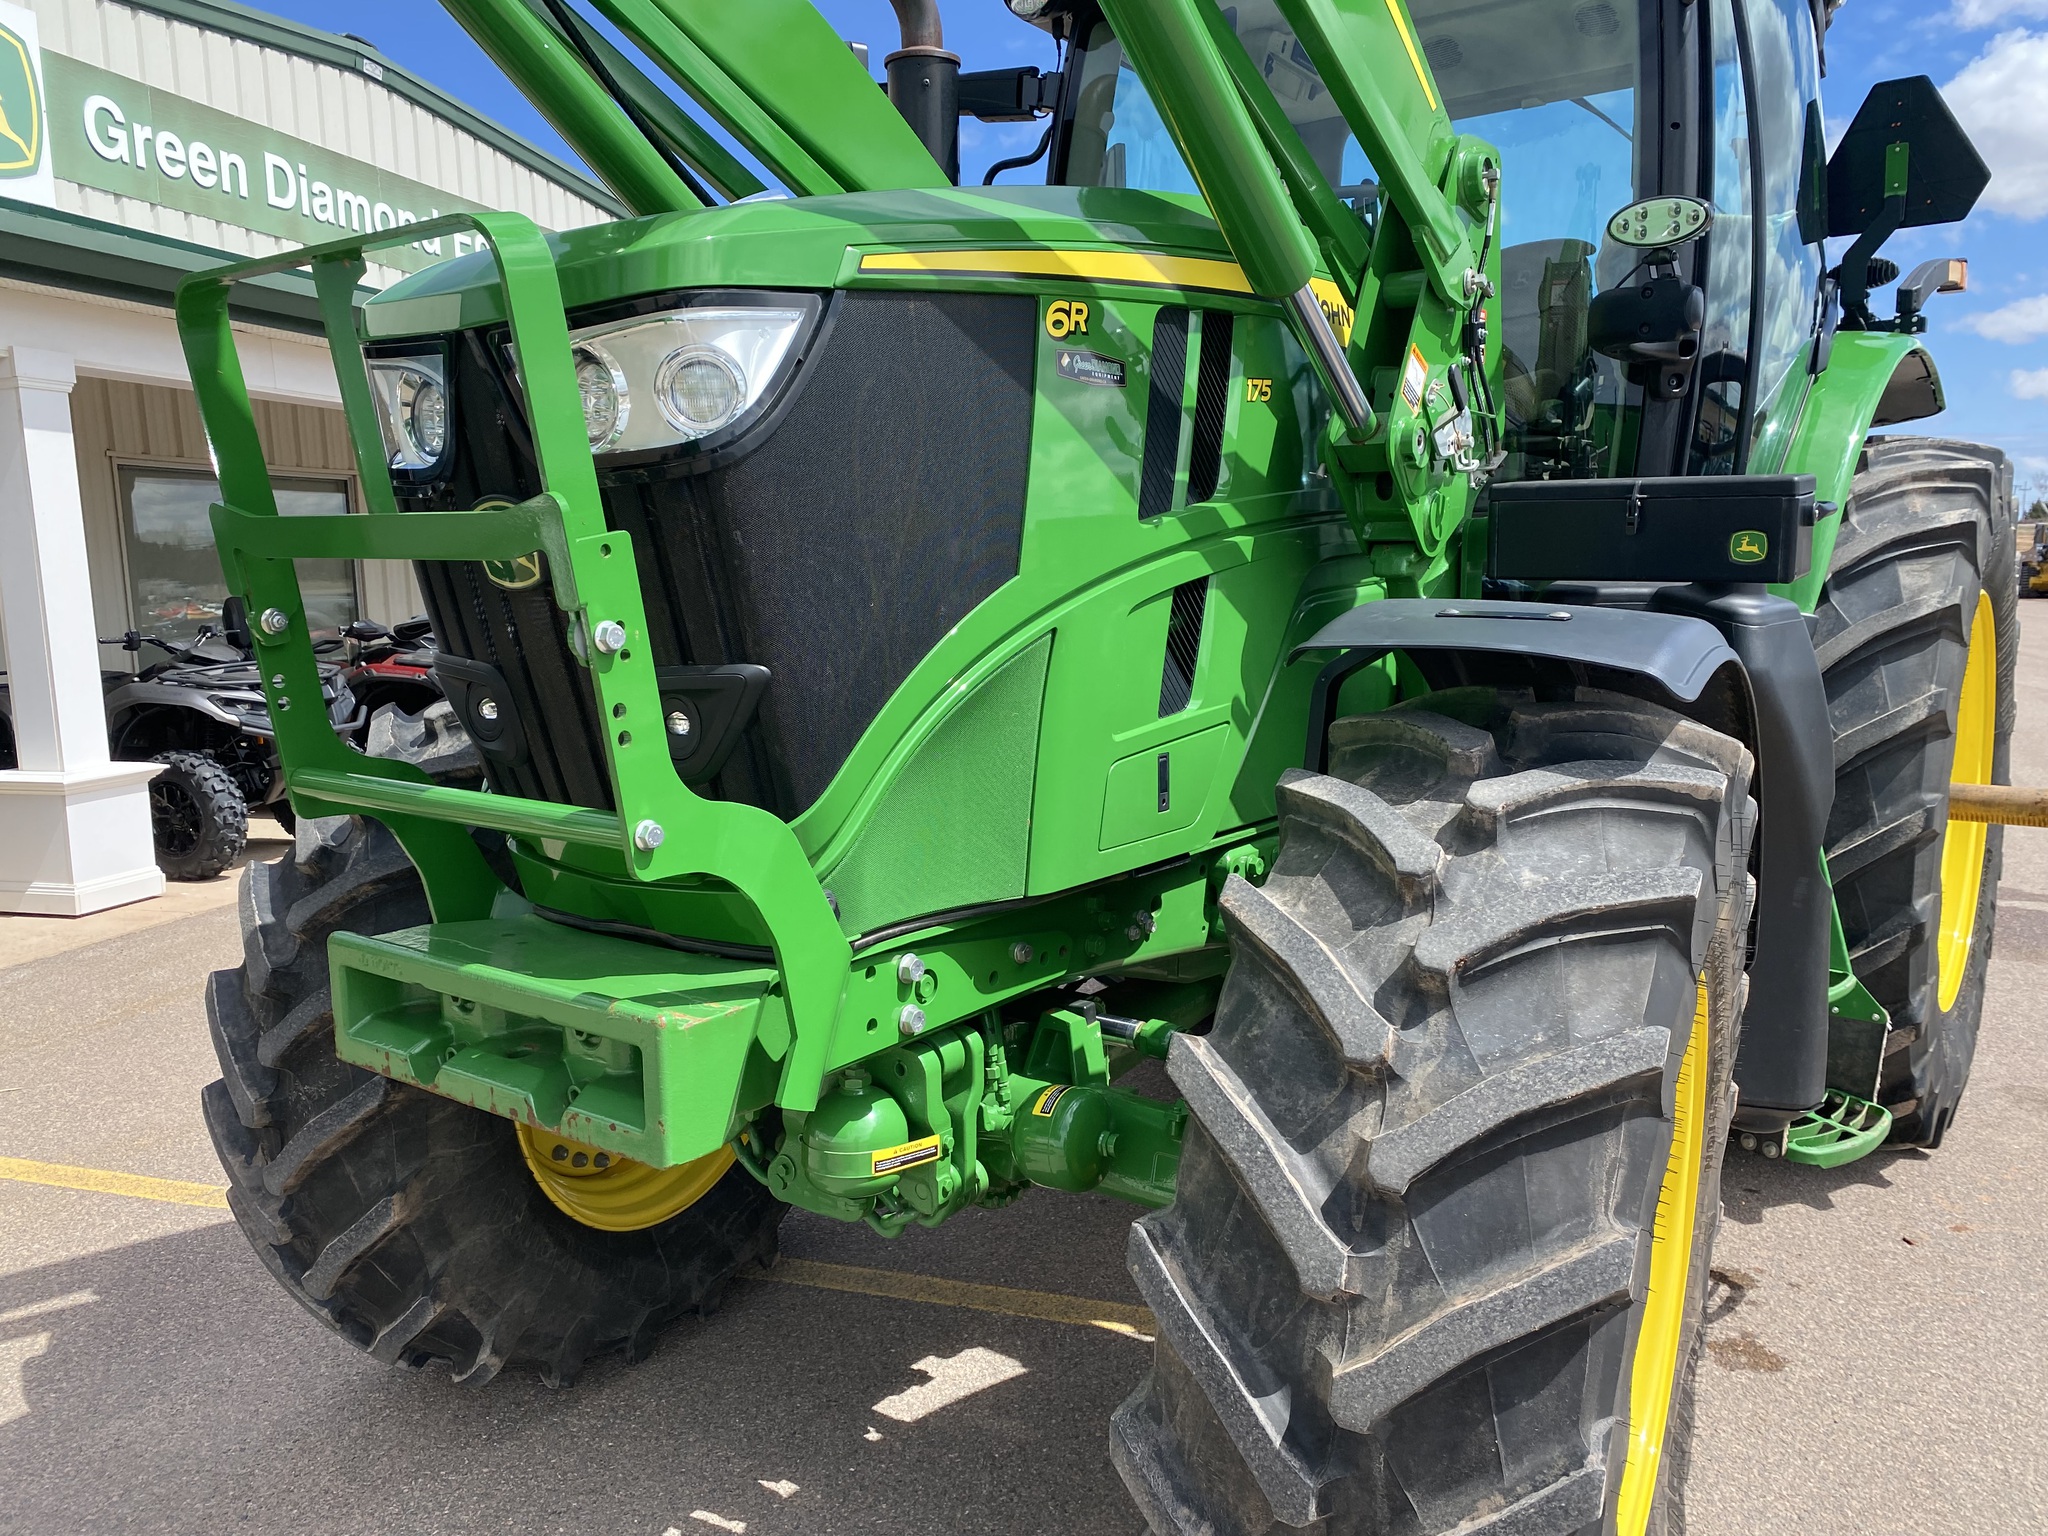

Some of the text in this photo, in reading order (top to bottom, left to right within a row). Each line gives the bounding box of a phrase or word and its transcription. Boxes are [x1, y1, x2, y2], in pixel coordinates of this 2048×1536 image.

[83, 94, 441, 256] Green Diamond
[1045, 299, 1091, 342] 6R
[1315, 292, 1351, 329] OHN
[1246, 377, 1272, 402] 175
[899, 1142, 923, 1153] CAUTION
